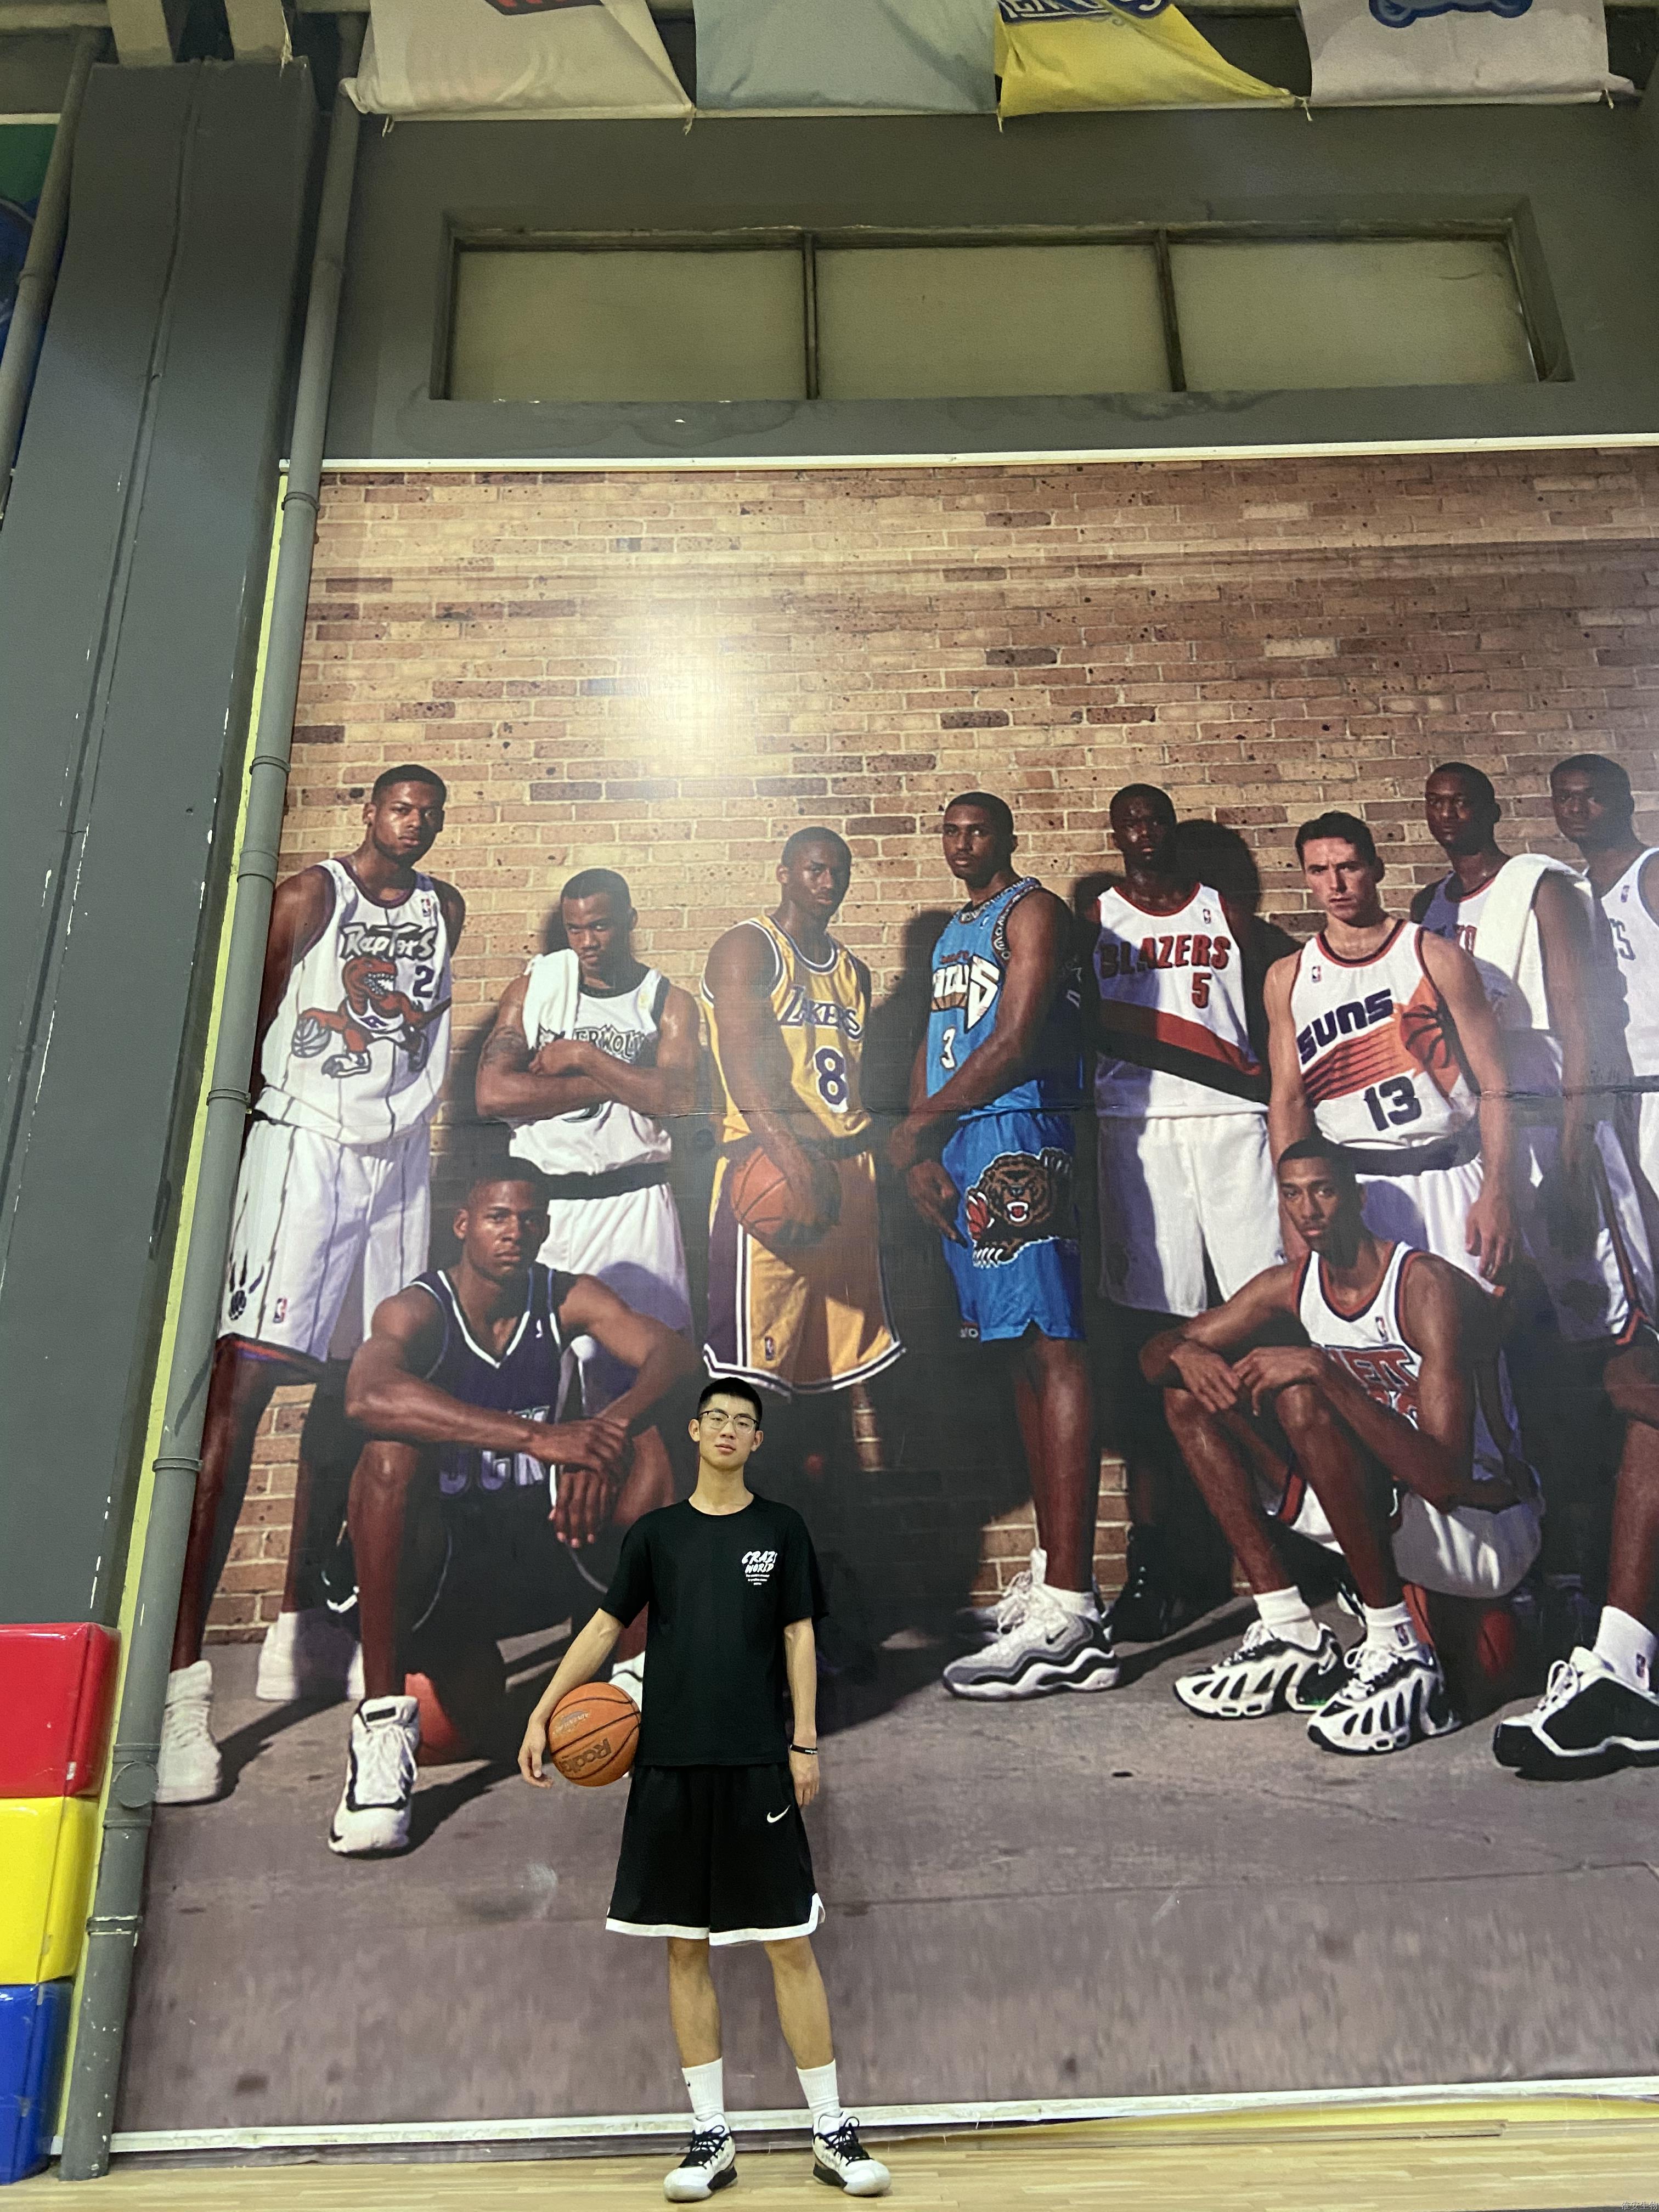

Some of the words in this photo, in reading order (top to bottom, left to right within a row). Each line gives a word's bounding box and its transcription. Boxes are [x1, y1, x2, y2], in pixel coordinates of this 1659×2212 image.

[1100, 934, 1231, 978] BLAZERS
[413, 965, 435, 998] 2
[1191, 972, 1212, 1008] 5
[940, 1026, 957, 1069] 3
[813, 1045, 848, 1107] 8
[1364, 1075, 1422, 1131] 13
[744, 1563, 774, 1573] WORLD
